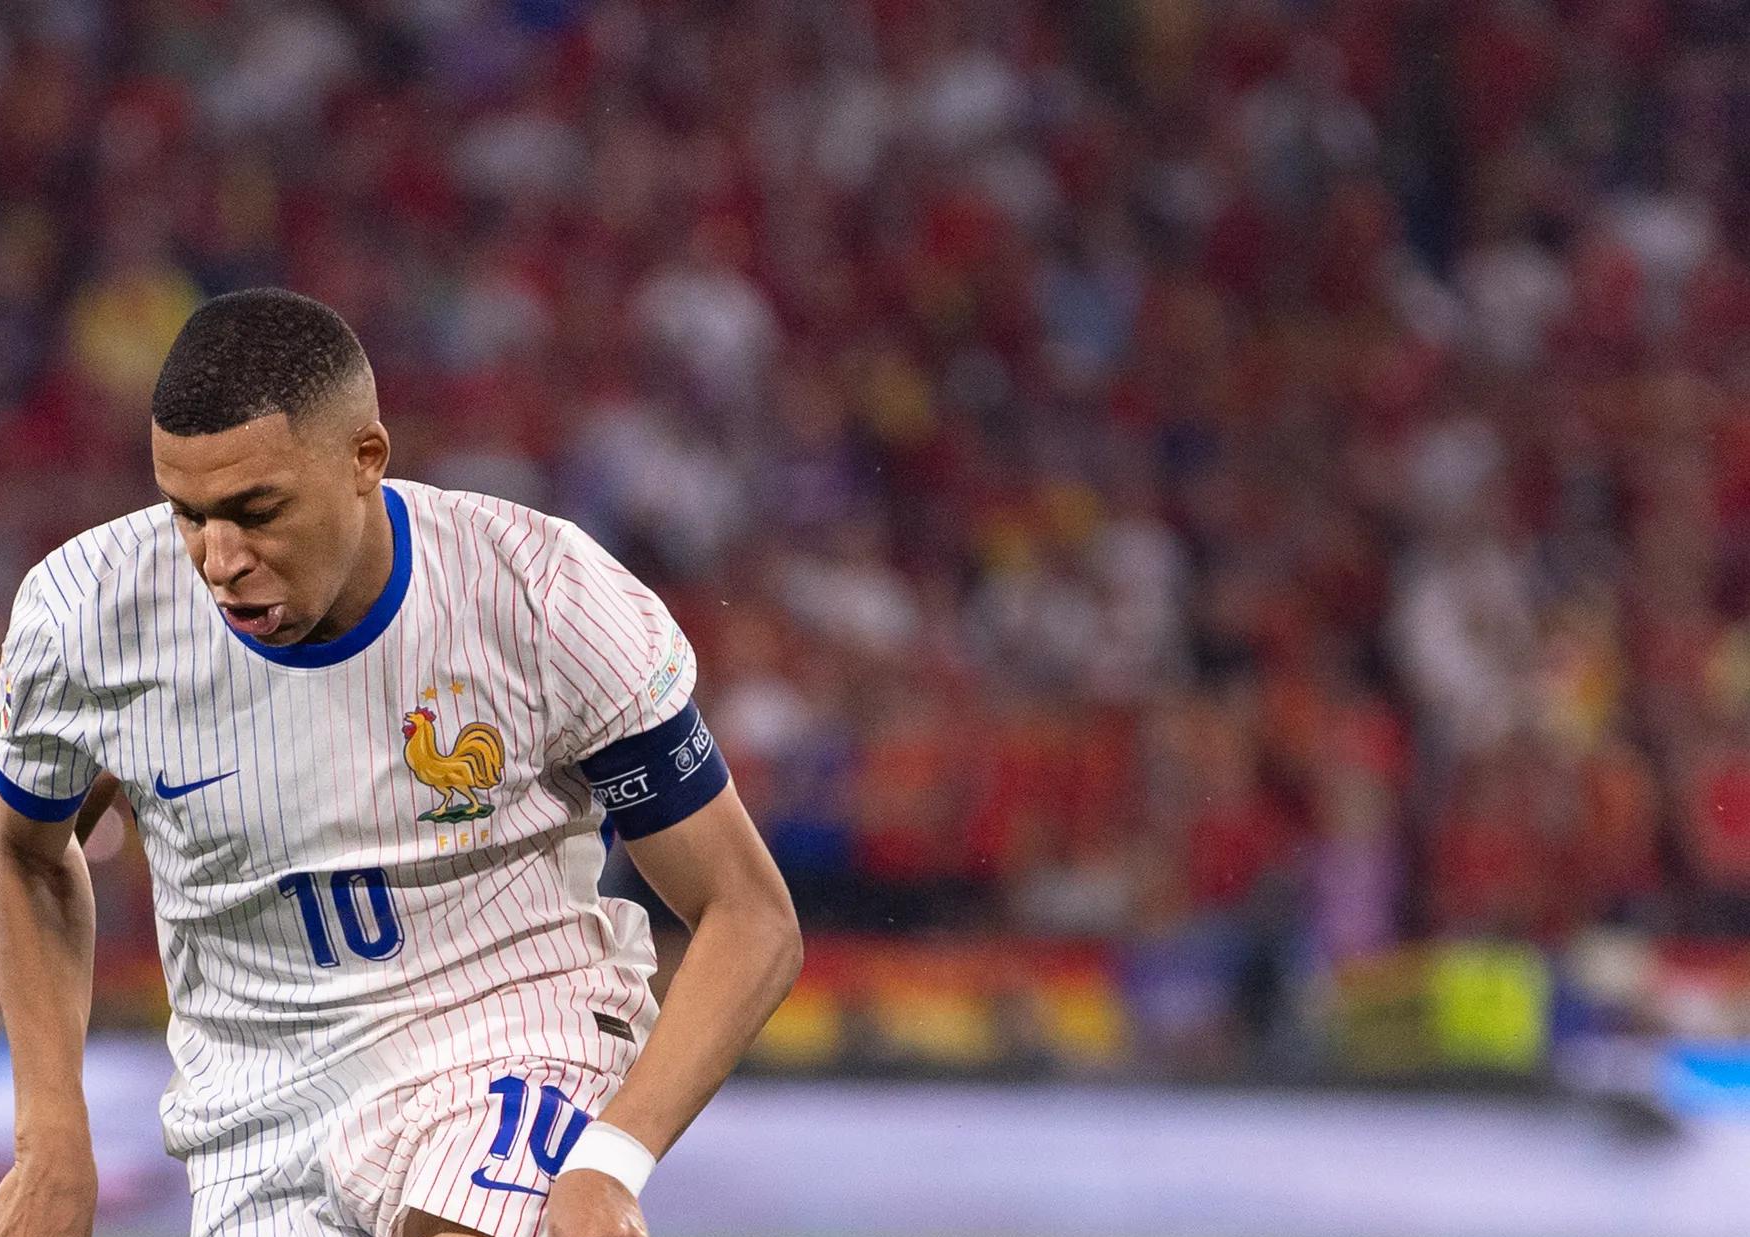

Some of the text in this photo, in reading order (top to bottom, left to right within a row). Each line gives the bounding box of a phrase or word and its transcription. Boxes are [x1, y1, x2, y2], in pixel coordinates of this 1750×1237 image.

[594, 773, 649, 805] PECT
[277, 866, 405, 968] 10
[489, 1076, 592, 1182] 10
